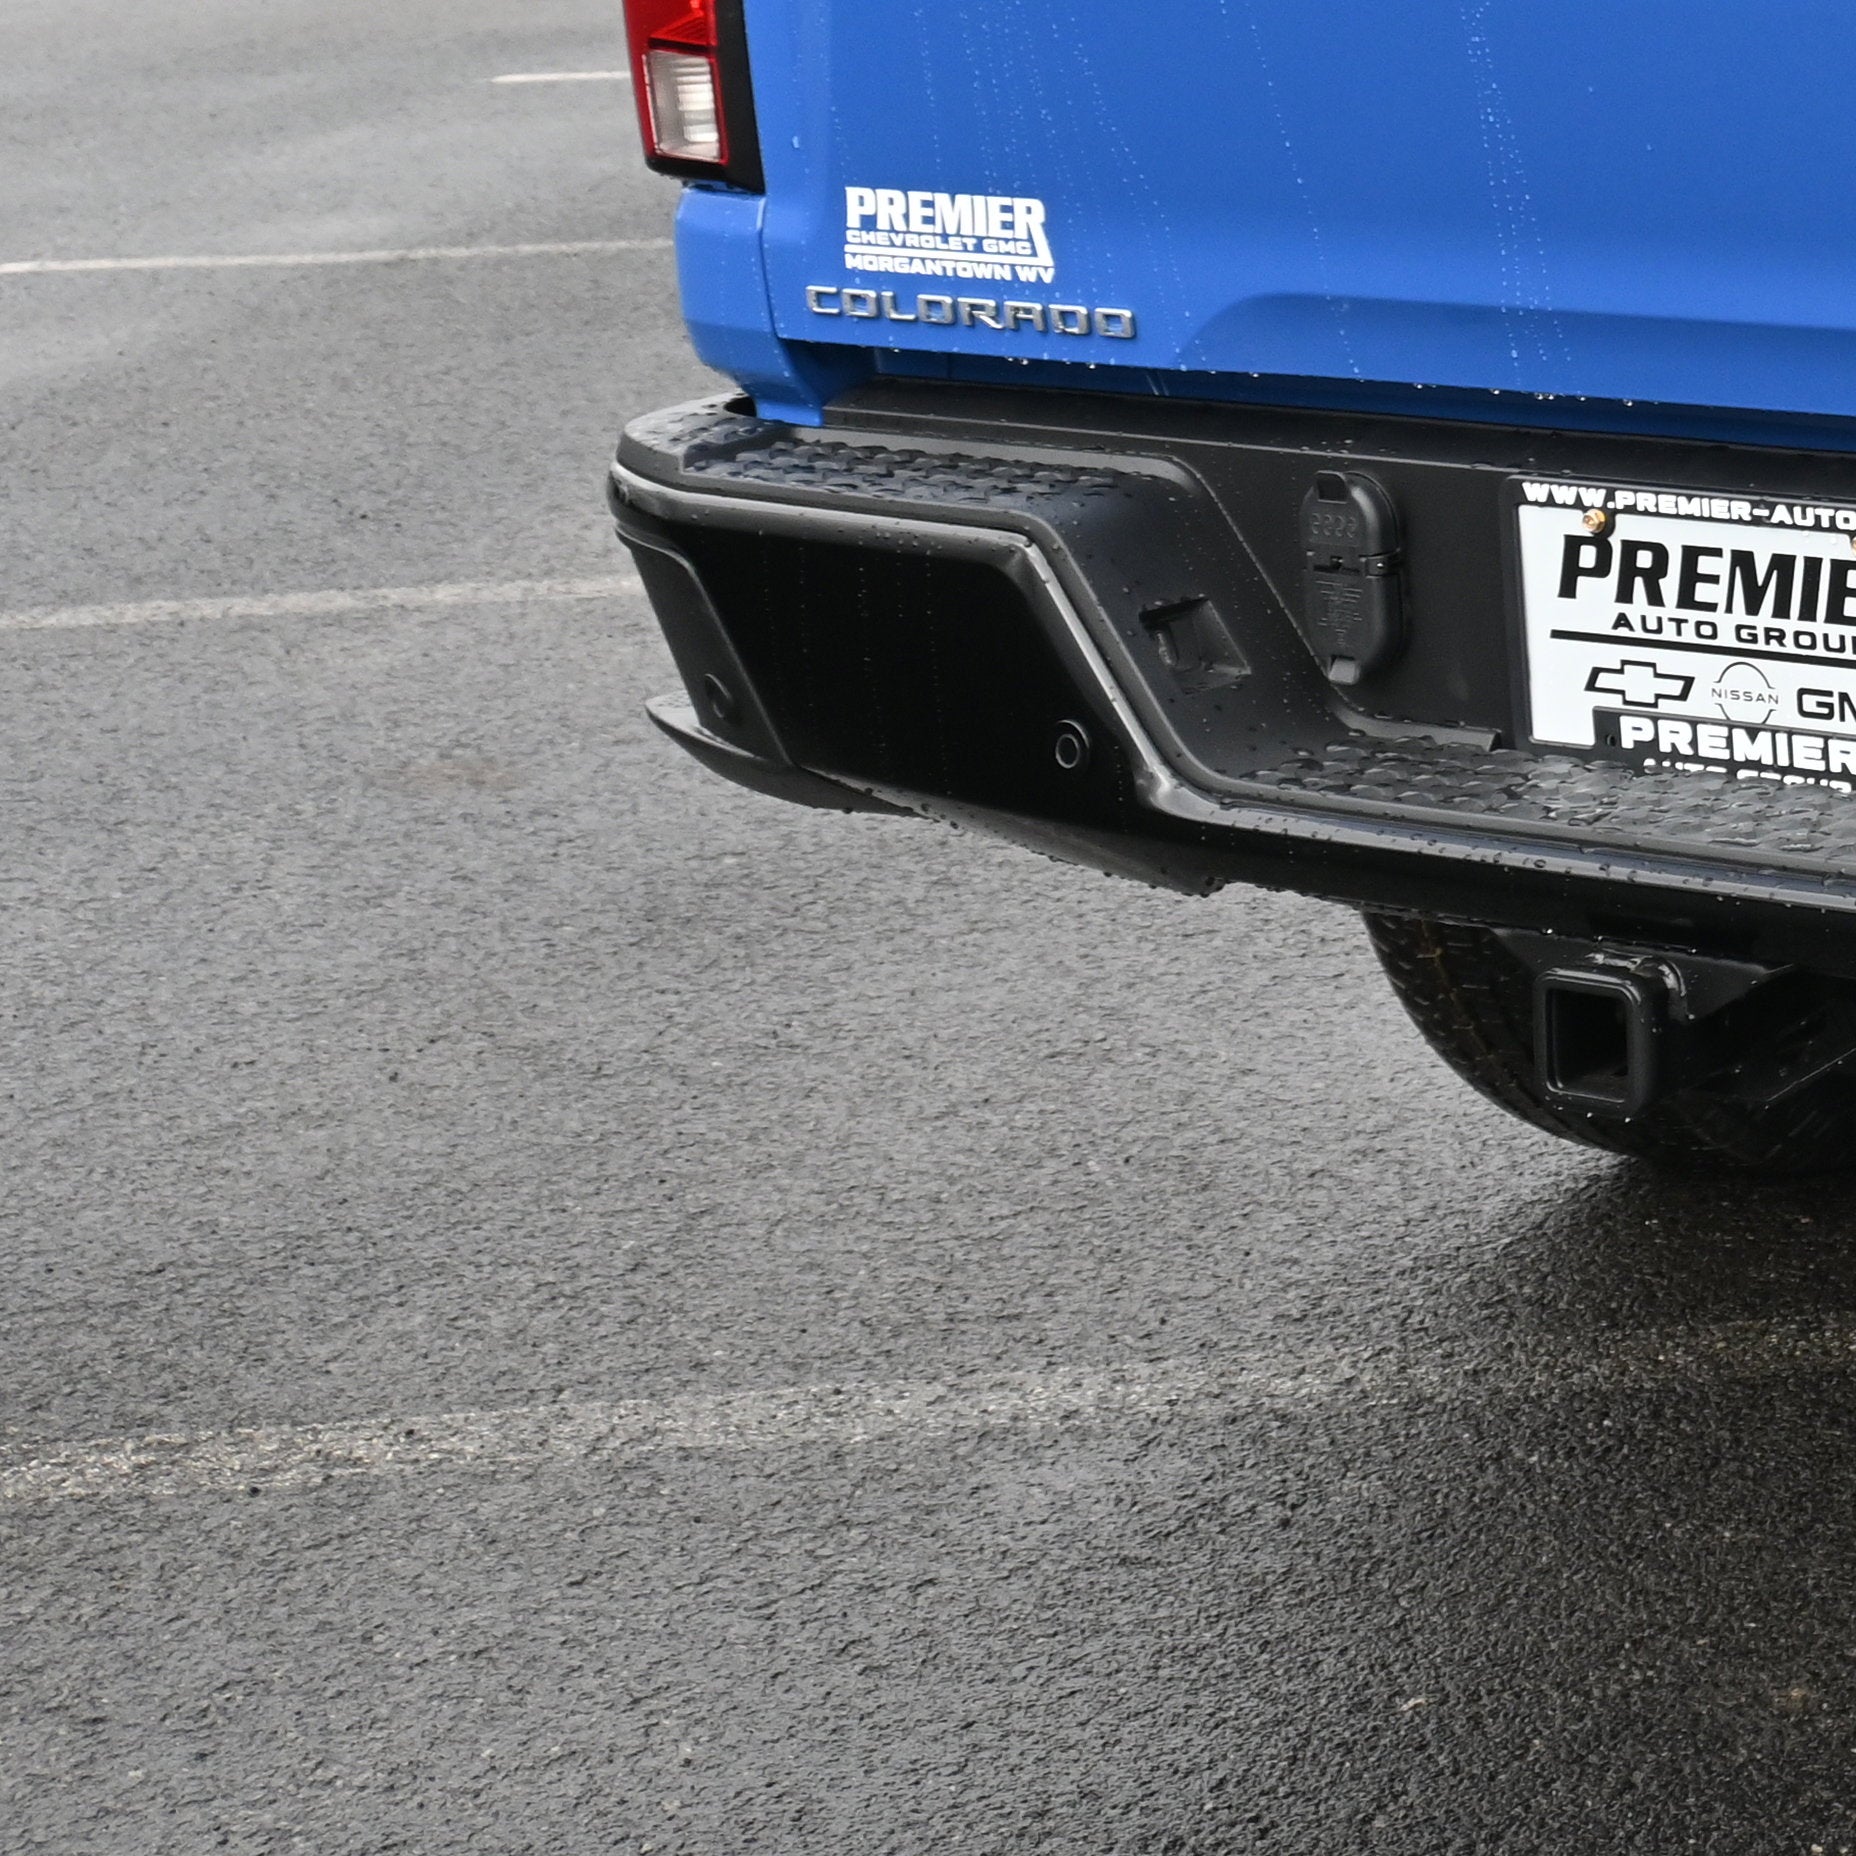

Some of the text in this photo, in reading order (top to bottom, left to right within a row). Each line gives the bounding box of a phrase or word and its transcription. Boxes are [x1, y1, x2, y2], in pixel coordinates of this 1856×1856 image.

[845, 186, 1050, 250] PREMIER
[846, 229, 1033, 255] CHEVROLET GMC
[845, 253, 1056, 284] MORGANTOWN WV
[805, 285, 1137, 339] COLORADO
[1611, 612, 1719, 640] AUTO
[1711, 687, 1780, 706] NISSAN
